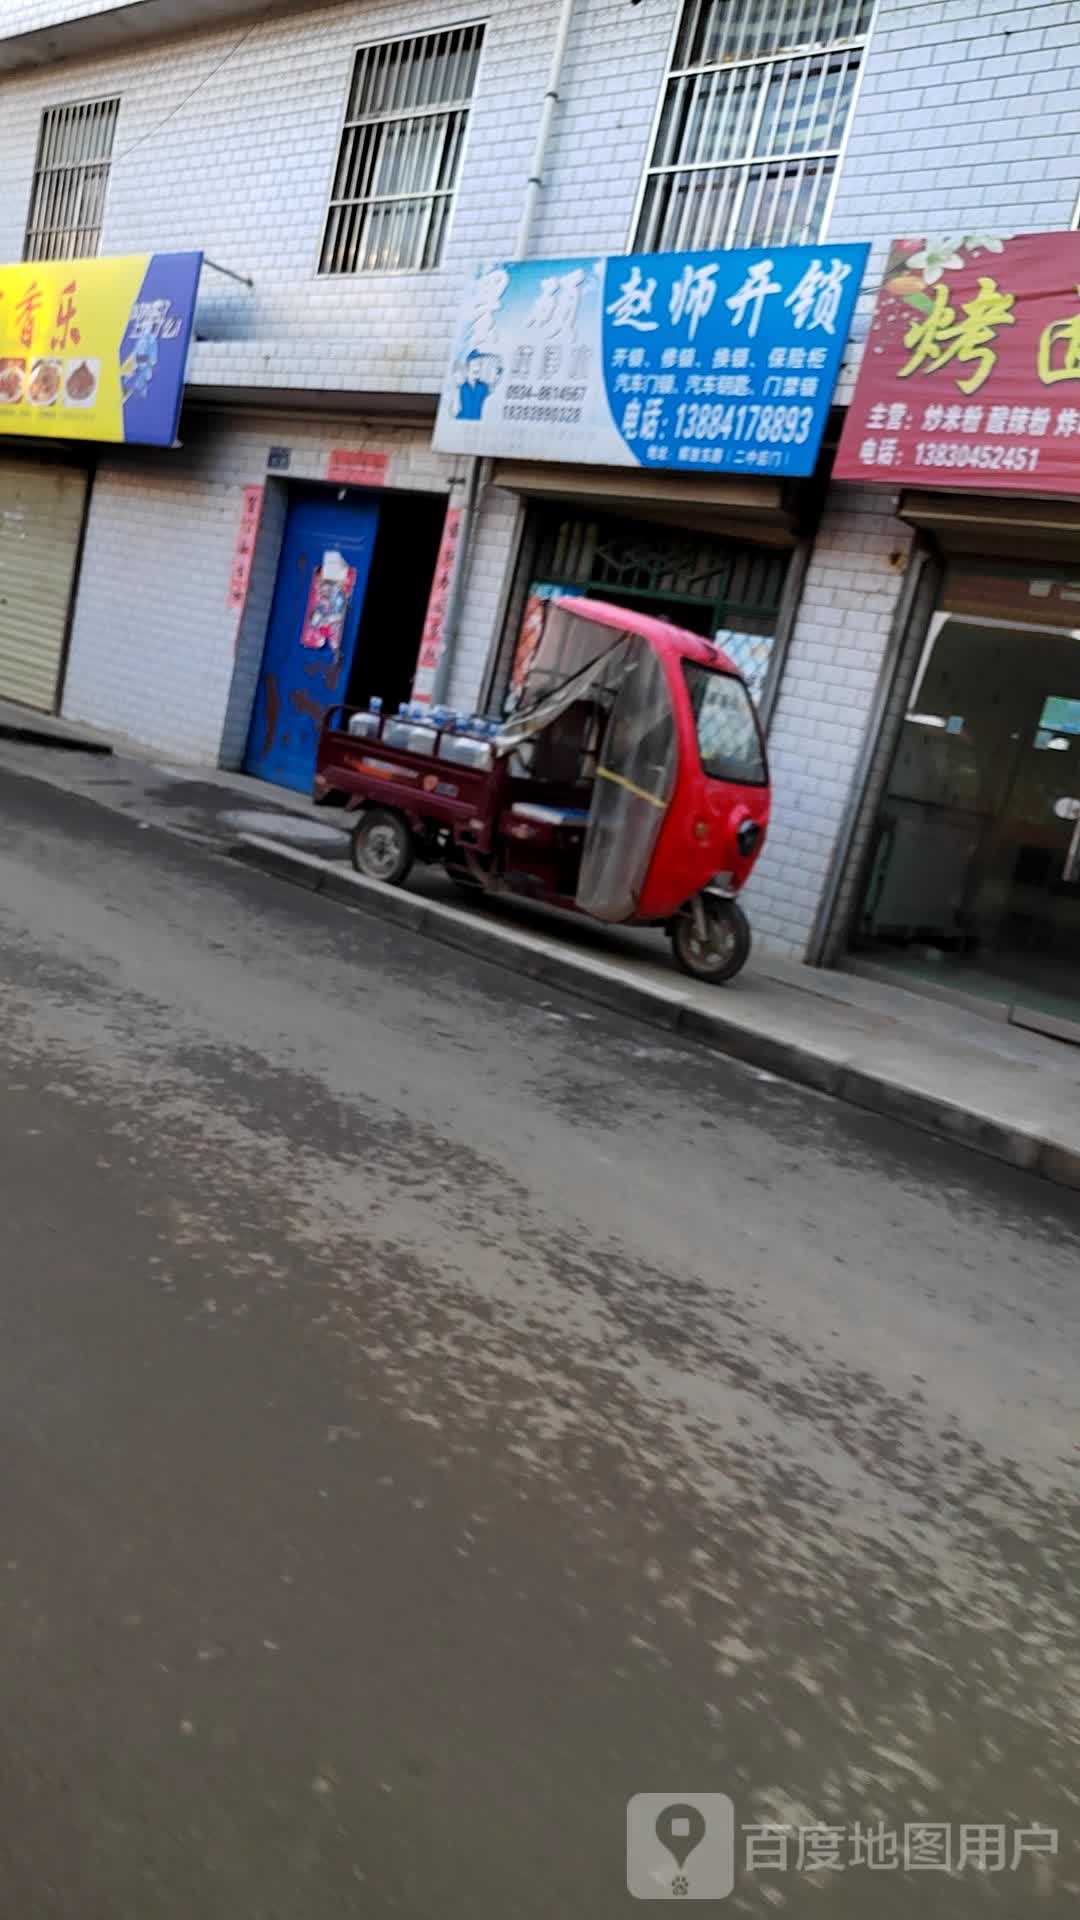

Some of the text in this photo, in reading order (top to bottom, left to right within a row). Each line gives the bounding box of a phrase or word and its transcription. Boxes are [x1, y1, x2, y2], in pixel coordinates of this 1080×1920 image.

[0, 280, 81, 350] 香乐
[605, 258, 853, 342] 赵师开锁
